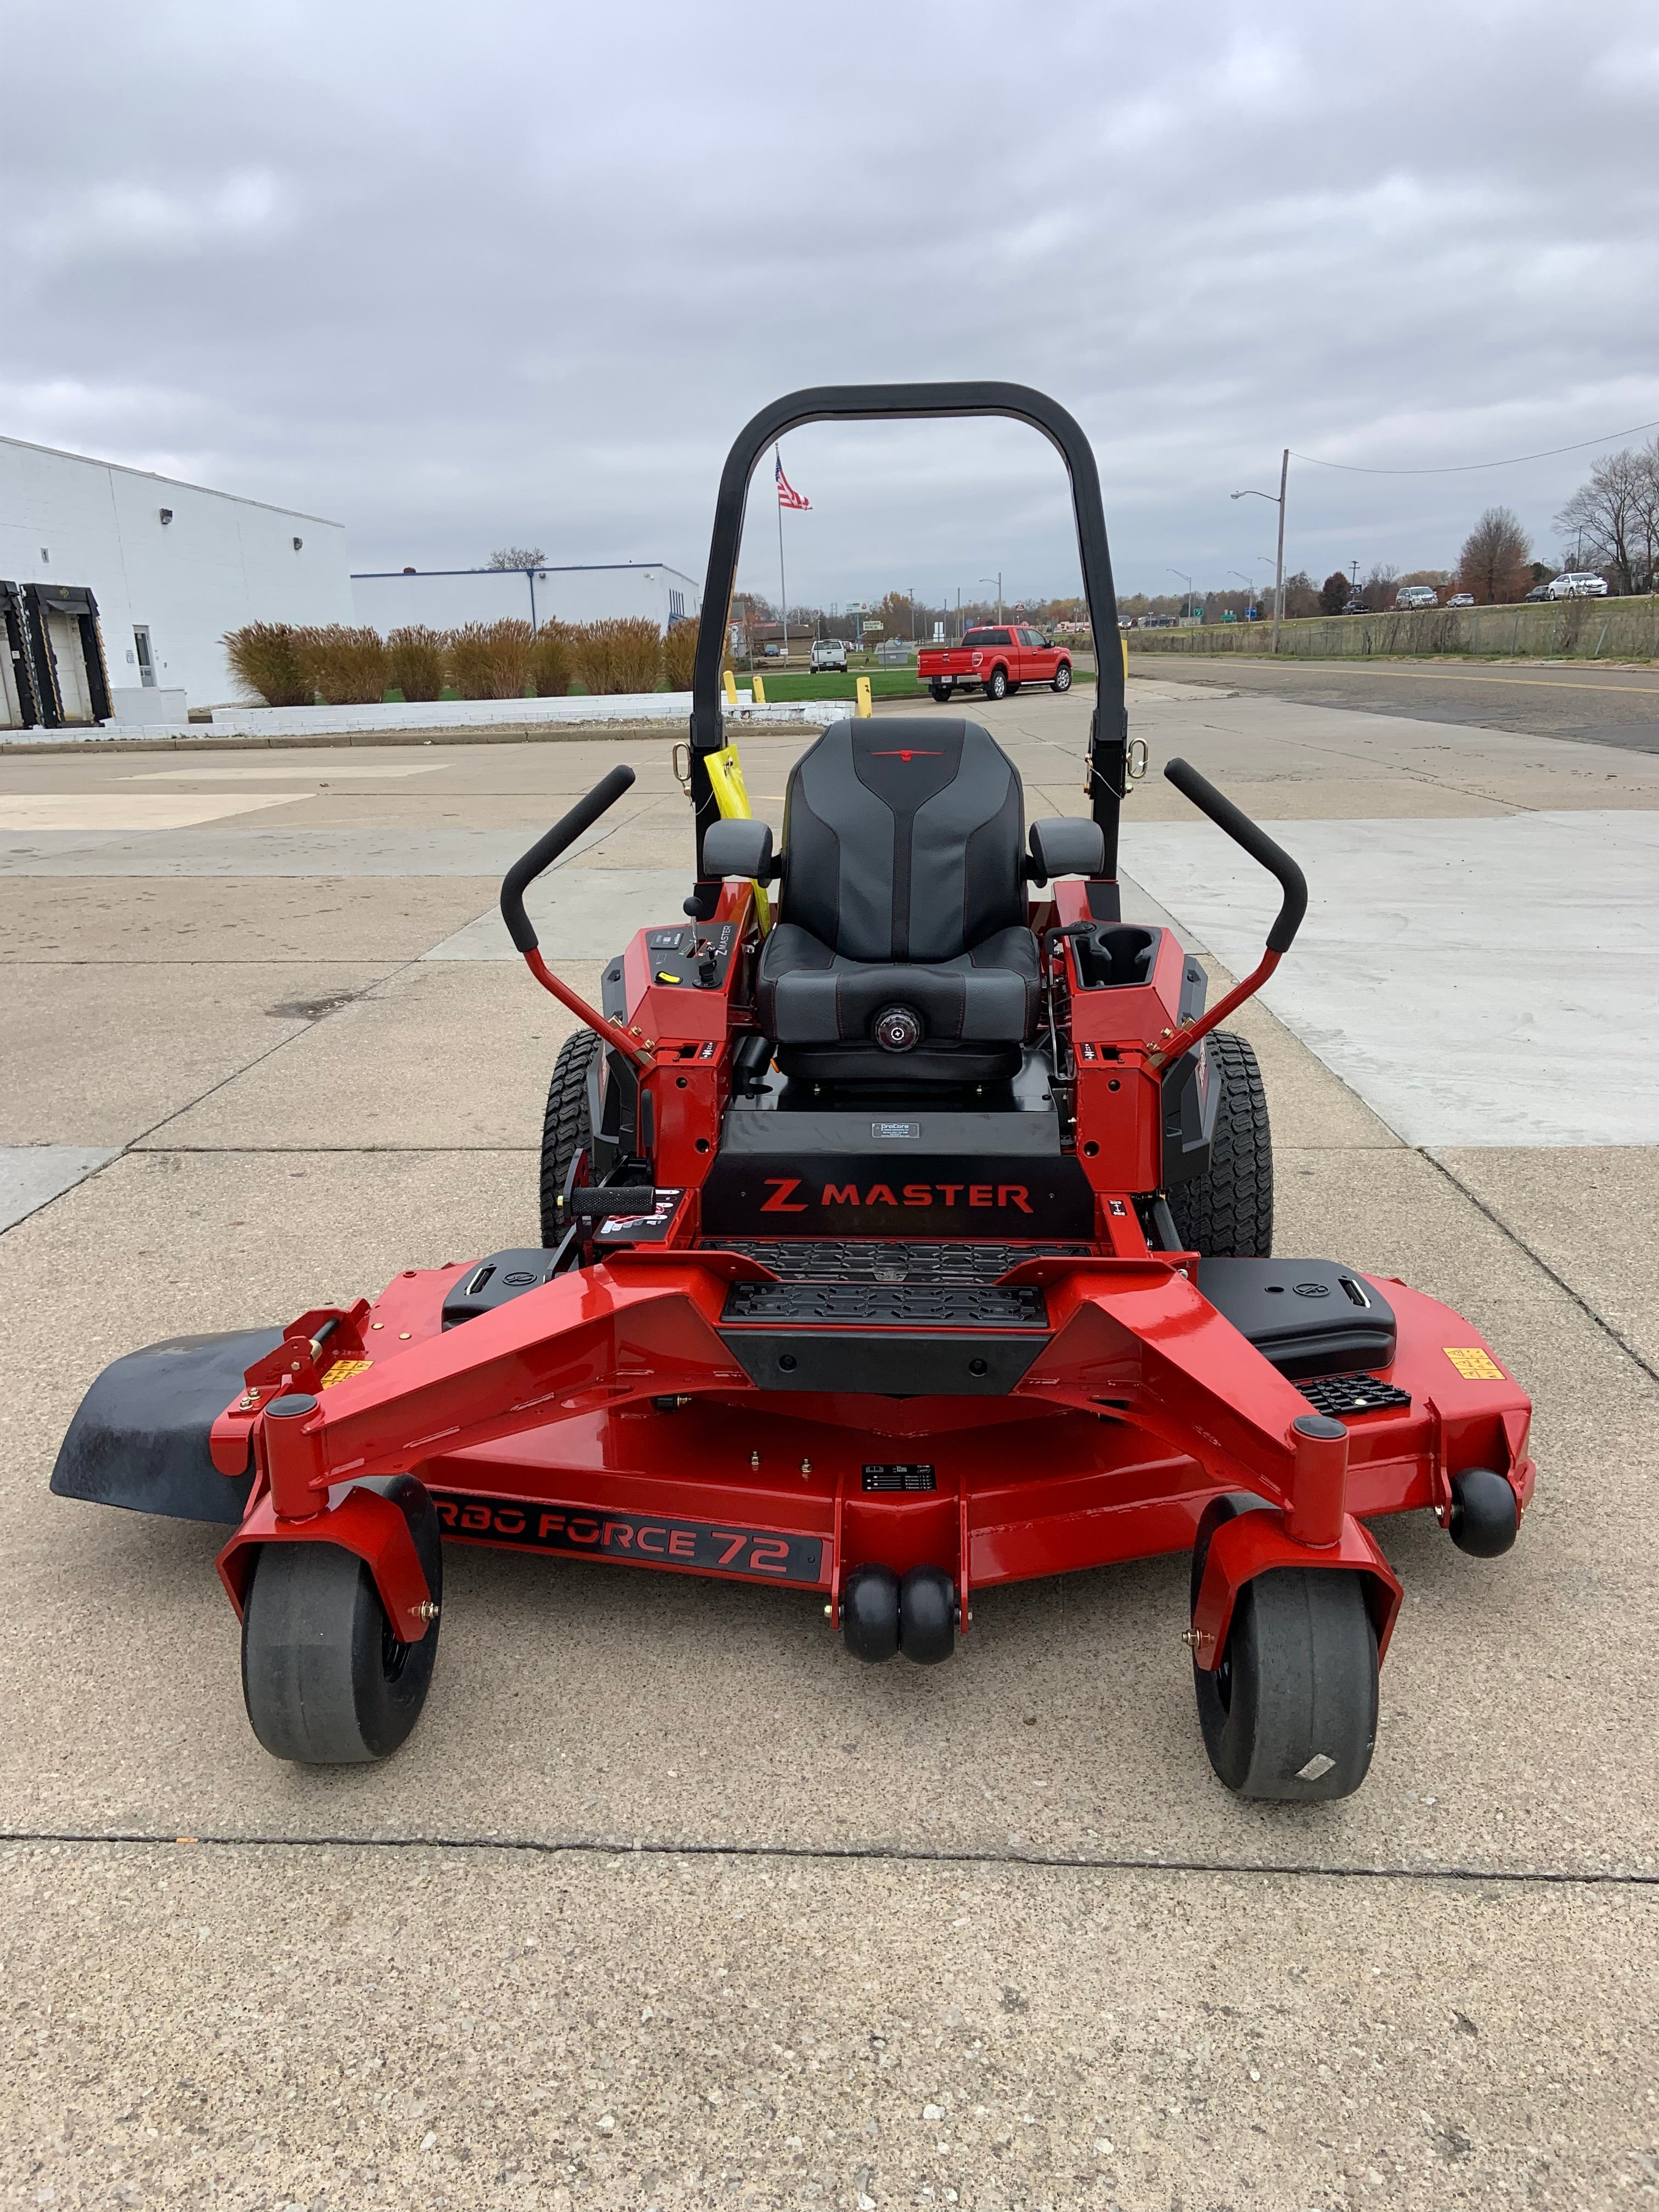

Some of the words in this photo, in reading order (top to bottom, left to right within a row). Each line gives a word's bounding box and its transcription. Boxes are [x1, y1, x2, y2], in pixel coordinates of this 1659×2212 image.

[718, 926, 732, 950] MASTER
[760, 1178, 809, 1212] Z
[821, 1183, 1034, 1213] MASTER
[433, 1500, 526, 1534] RBO
[538, 1512, 697, 1557] FORCE
[710, 1531, 791, 1573] 72
